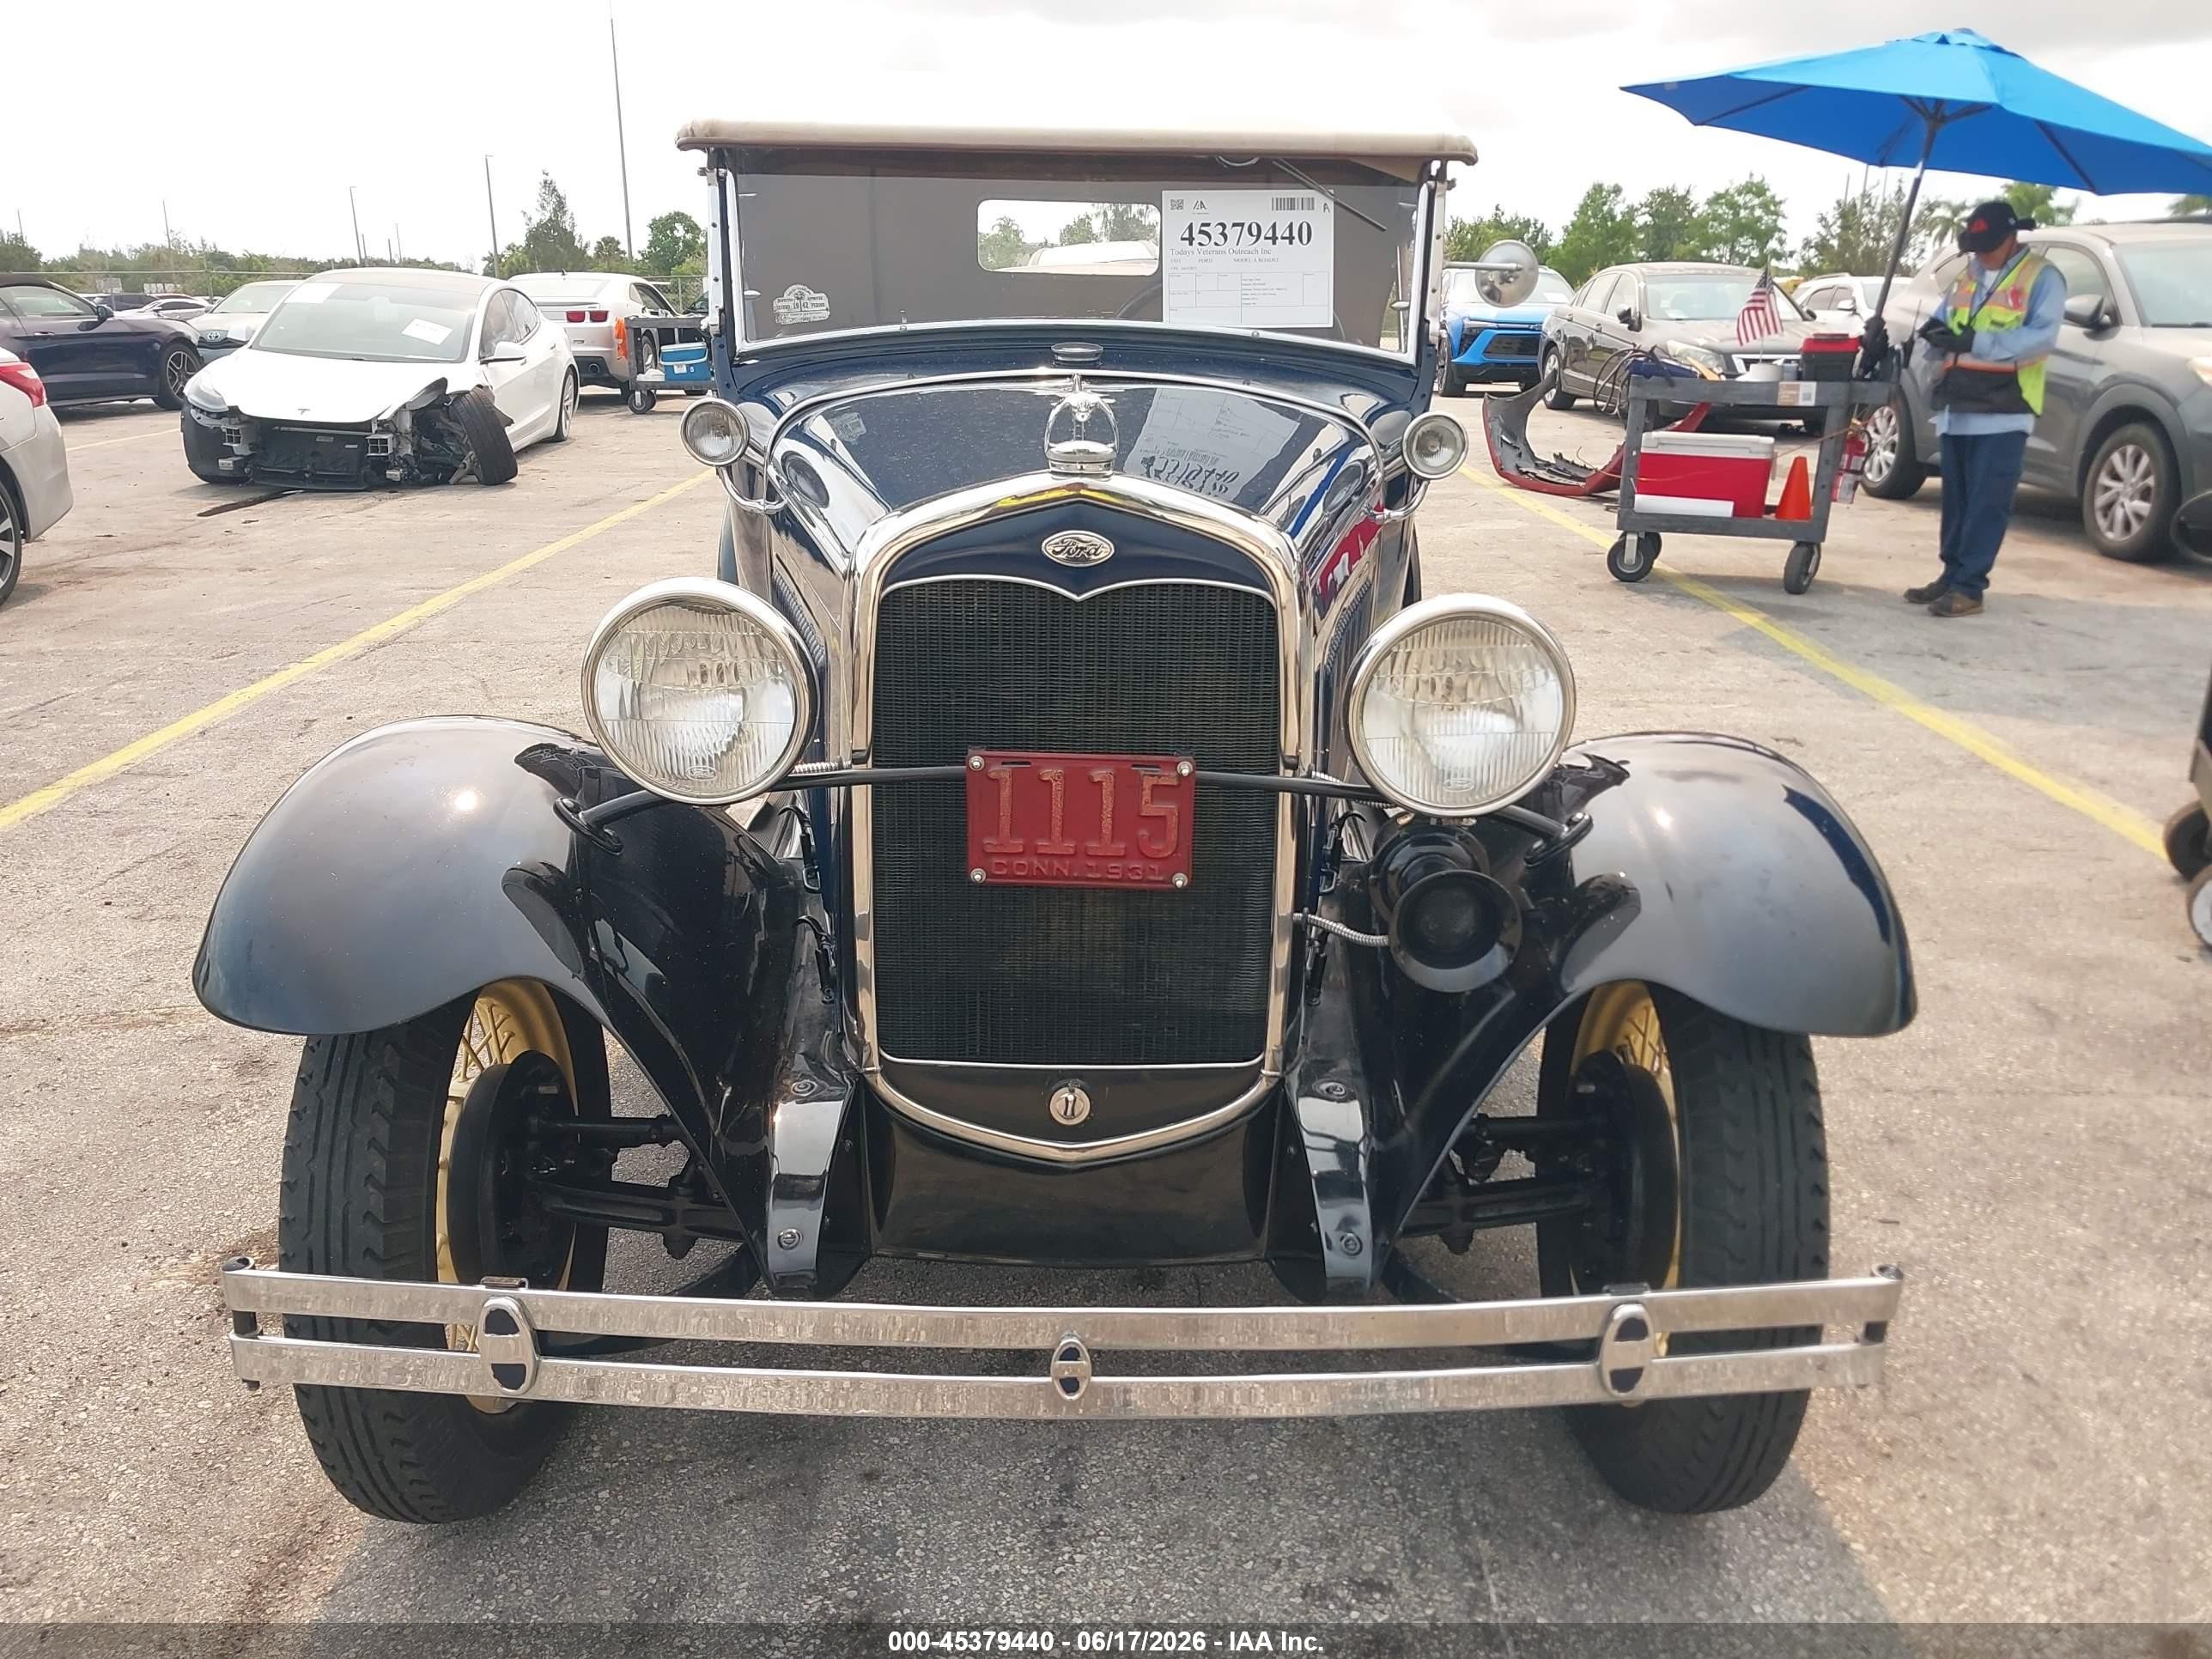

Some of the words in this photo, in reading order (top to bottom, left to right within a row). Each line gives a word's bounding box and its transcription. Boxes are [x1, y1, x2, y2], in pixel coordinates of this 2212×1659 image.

[1180, 221, 1312, 246] 45379440
[1170, 248, 1194, 257] Todays
[1047, 536, 1103, 558] Ford
[982, 768, 1182, 860] 1115
